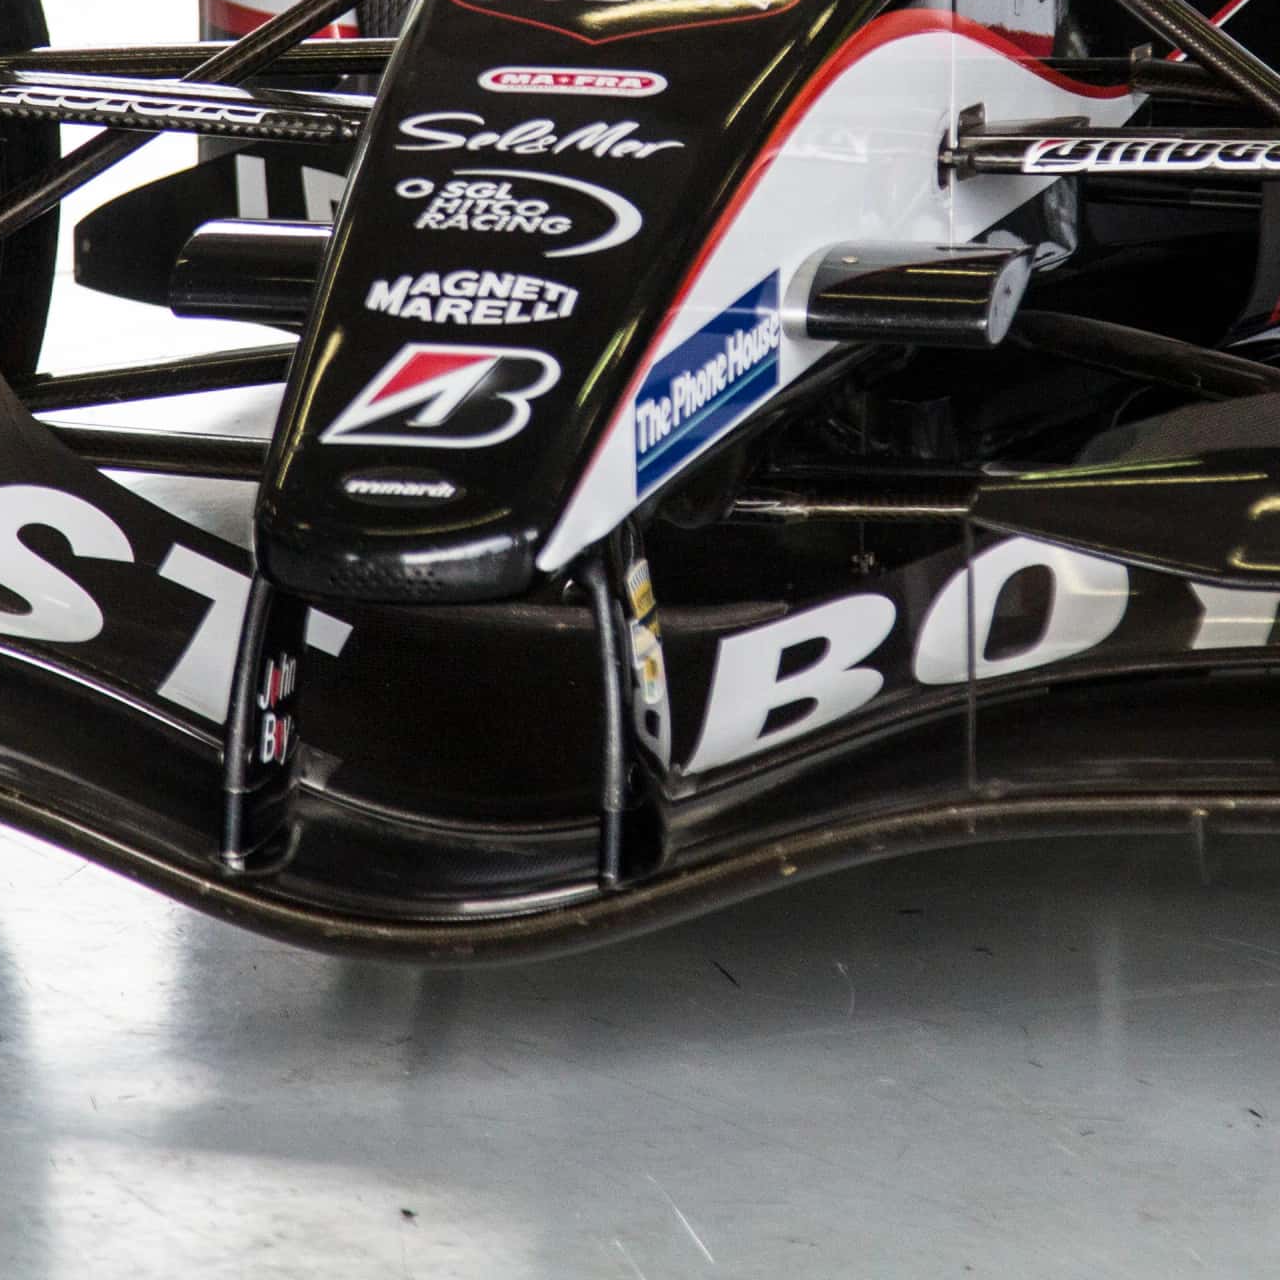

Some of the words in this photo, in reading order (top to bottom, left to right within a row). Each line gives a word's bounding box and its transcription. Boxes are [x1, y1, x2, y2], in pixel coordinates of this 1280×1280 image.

[441, 181, 513, 200] SGL
[427, 197, 549, 217] HITCO
[414, 213, 572, 234] RACING
[637, 396, 671, 454] The
[672, 353, 727, 427] Phone
[728, 310, 781, 383] House
